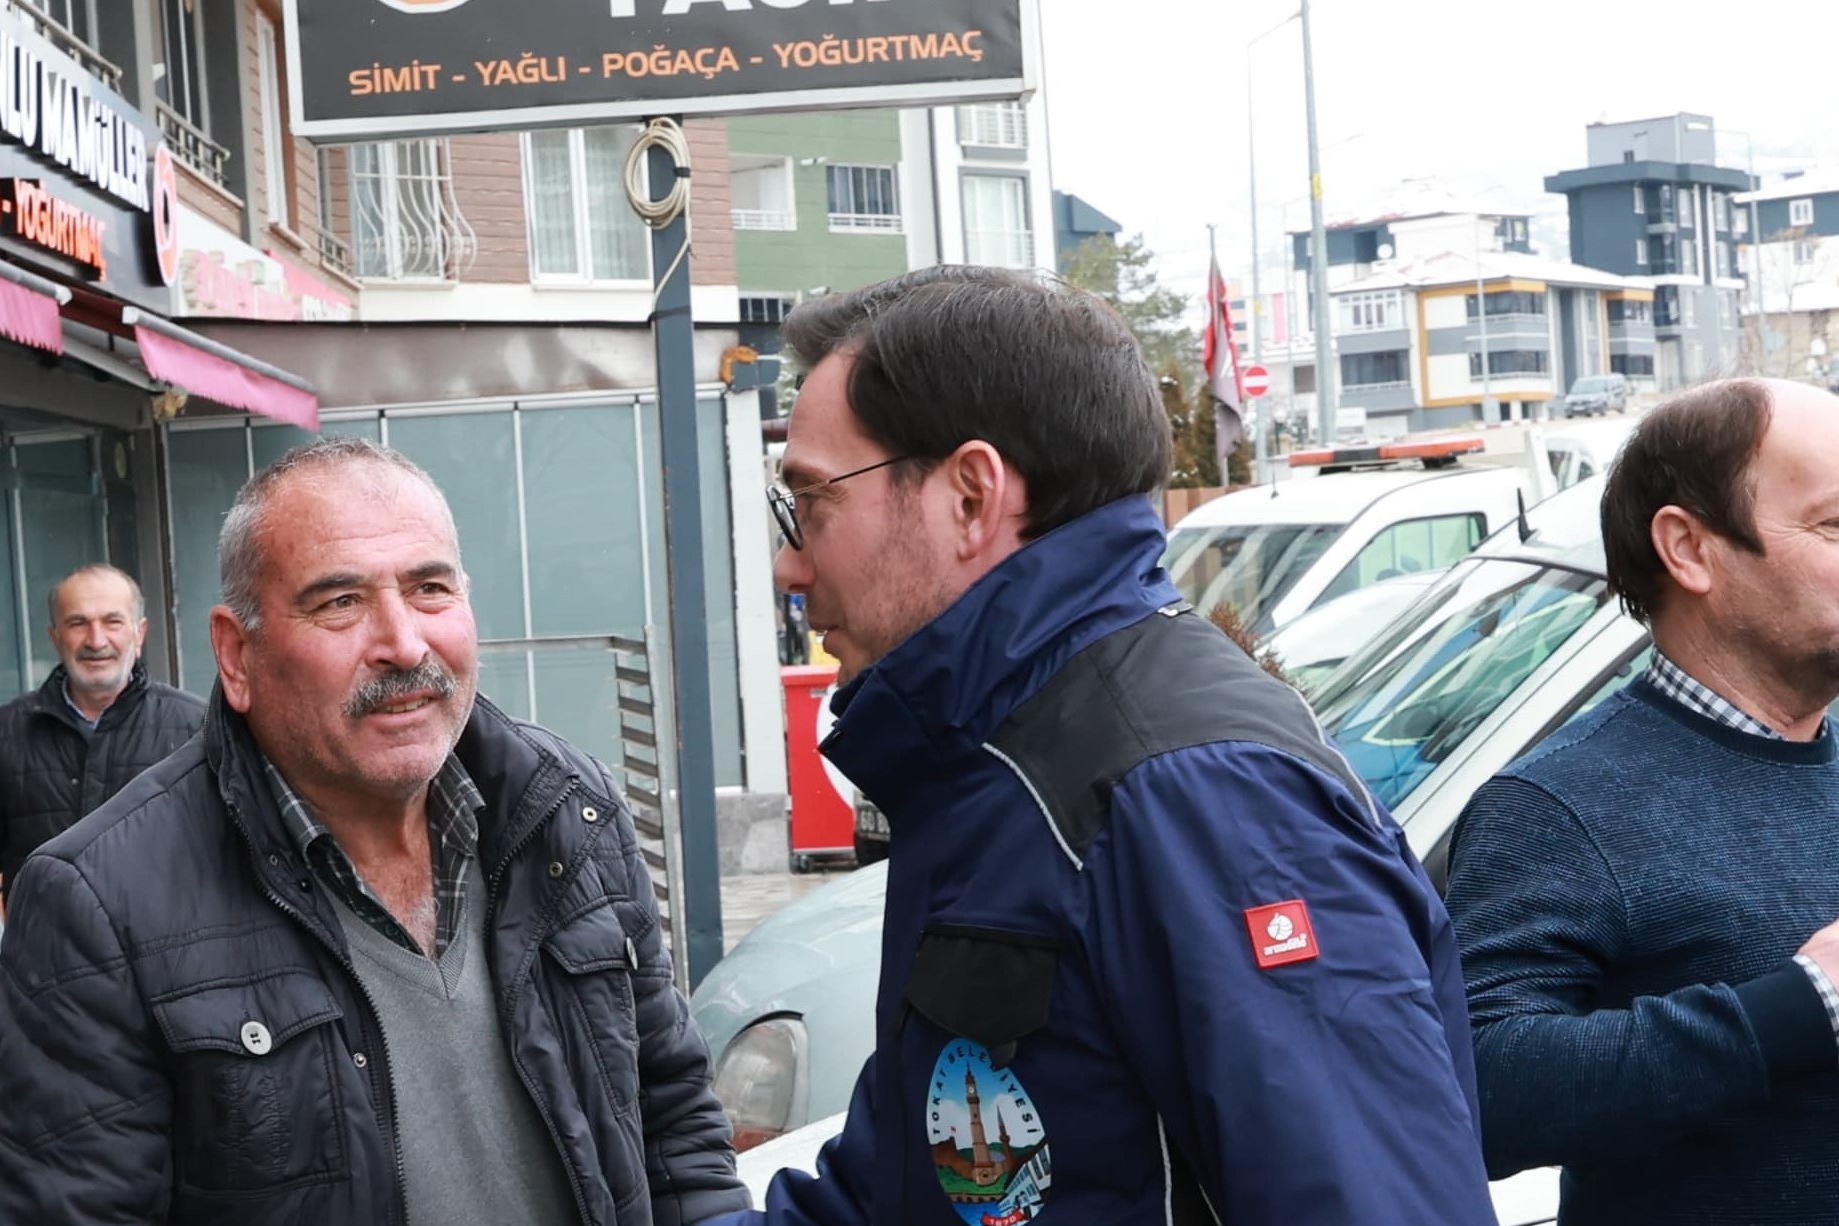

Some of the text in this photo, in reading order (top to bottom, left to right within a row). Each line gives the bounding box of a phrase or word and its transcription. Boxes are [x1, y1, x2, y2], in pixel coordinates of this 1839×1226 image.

[348, 59, 442, 96] SİMİT
[474, 52, 567, 87] YAĞLI
[602, 44, 740, 80] POĞAÇA
[772, 31, 984, 70] YOĞURTMAÇ
[931, 1045, 1041, 1136] TOKAT BELEİYESİ
